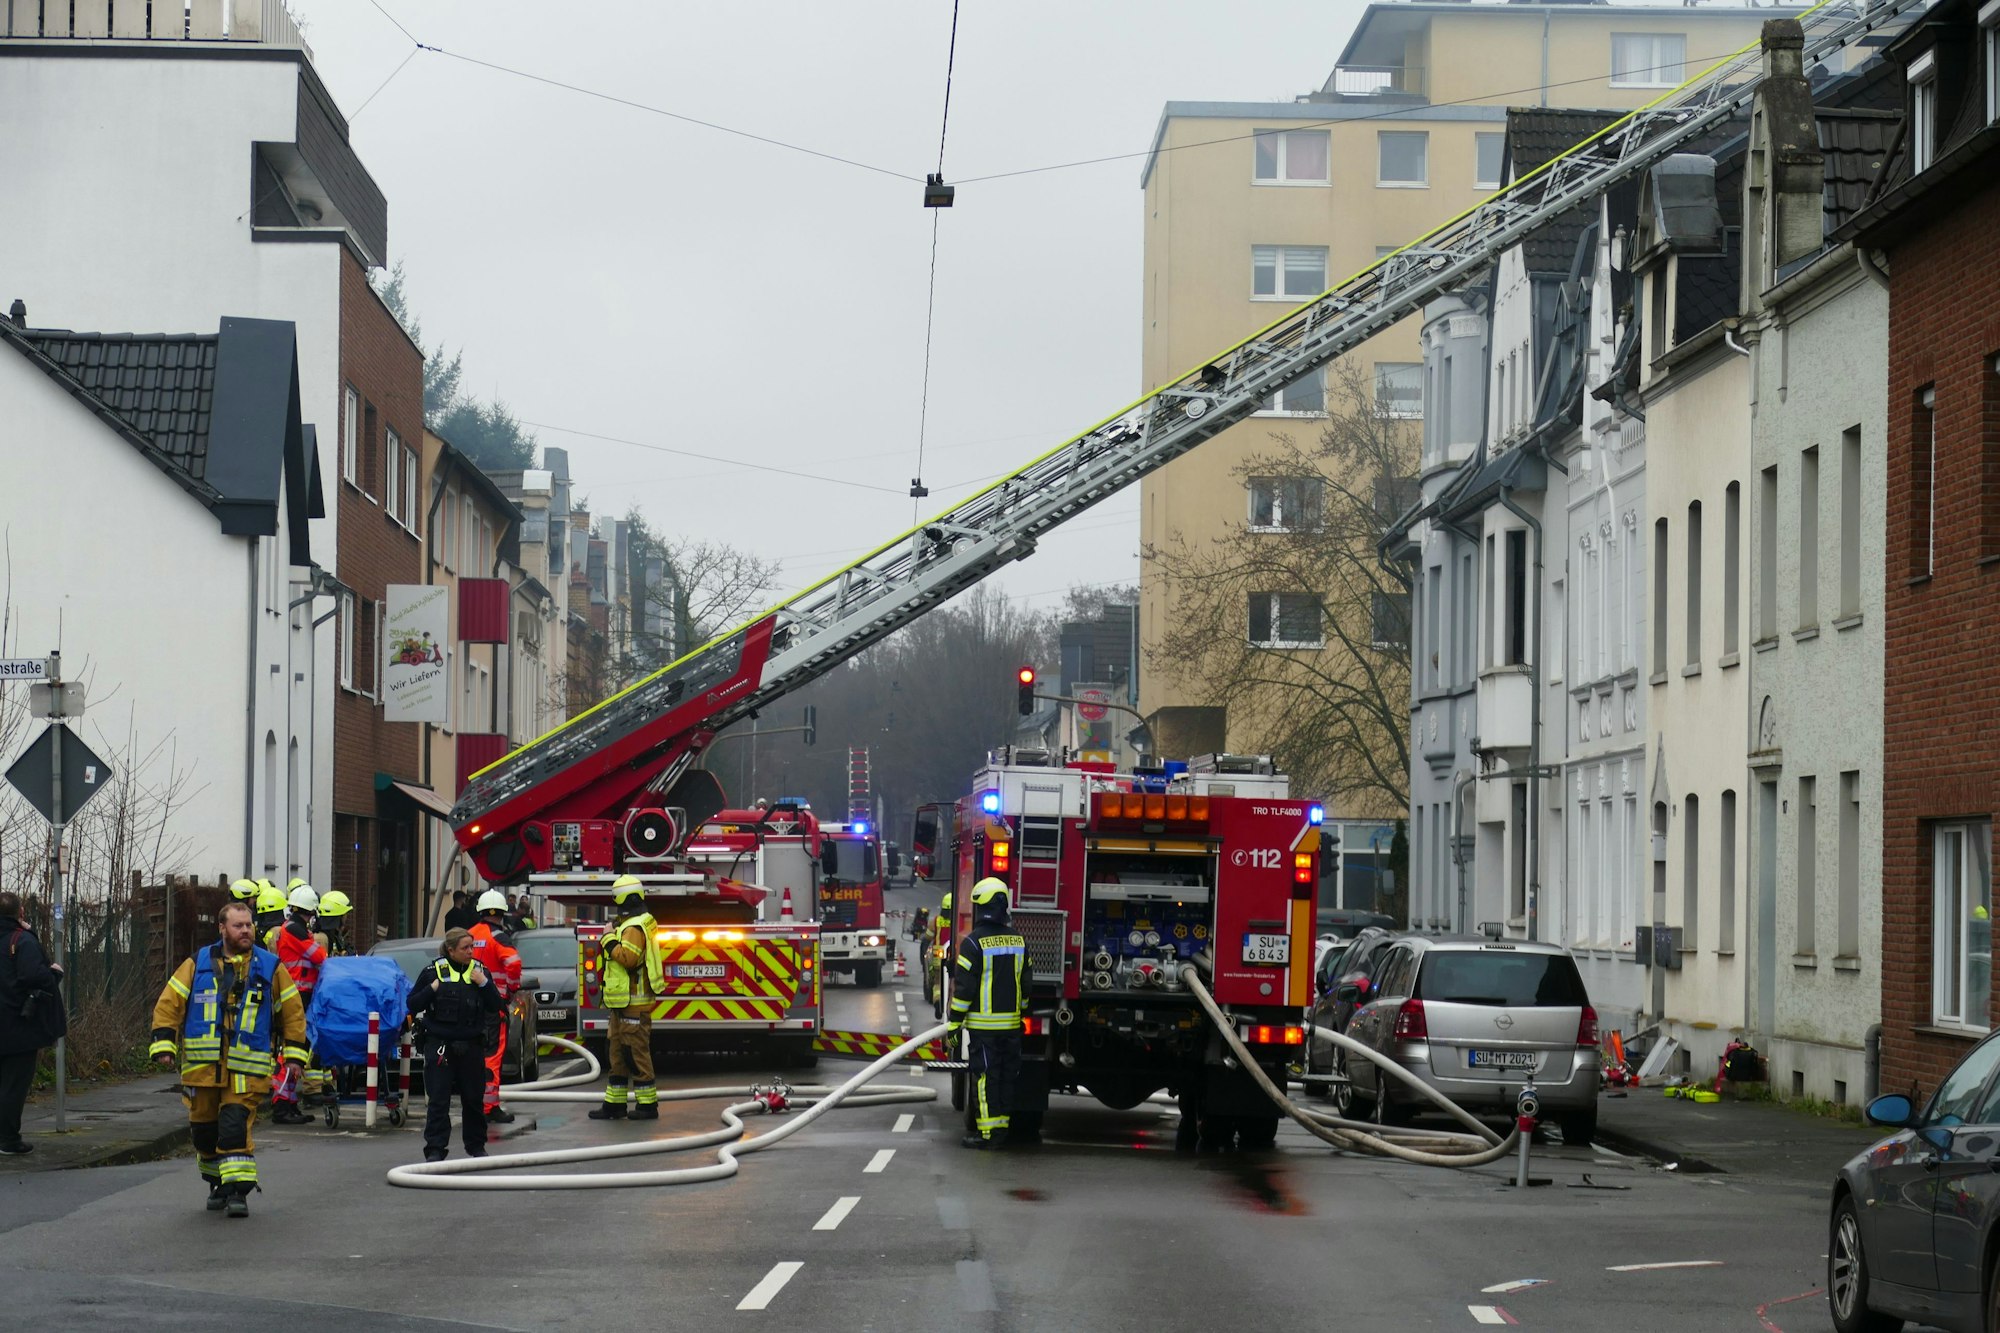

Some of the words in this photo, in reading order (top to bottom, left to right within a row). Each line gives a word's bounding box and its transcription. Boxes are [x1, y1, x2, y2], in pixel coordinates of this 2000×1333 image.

[390, 680, 407, 691] Wir
[410, 670, 441, 685] Liefern
[1252, 806, 1268, 816] TRO
[1270, 807, 1302, 817] TLF4000
[1248, 848, 1282, 869] 112
[819, 888, 863, 901] WEHR
[980, 936, 1024, 948] FEUERWEHR
[1259, 936, 1275, 948] SU
[1248, 949, 1284, 961] 6843
[678, 966, 688, 976] SU
[693, 966, 704, 976] FW
[704, 966, 723, 976] 2331
[1476, 1052, 1489, 1063] SU
[1495, 1053, 1508, 1064] MT
[1509, 1054, 1533, 1065] 2021
